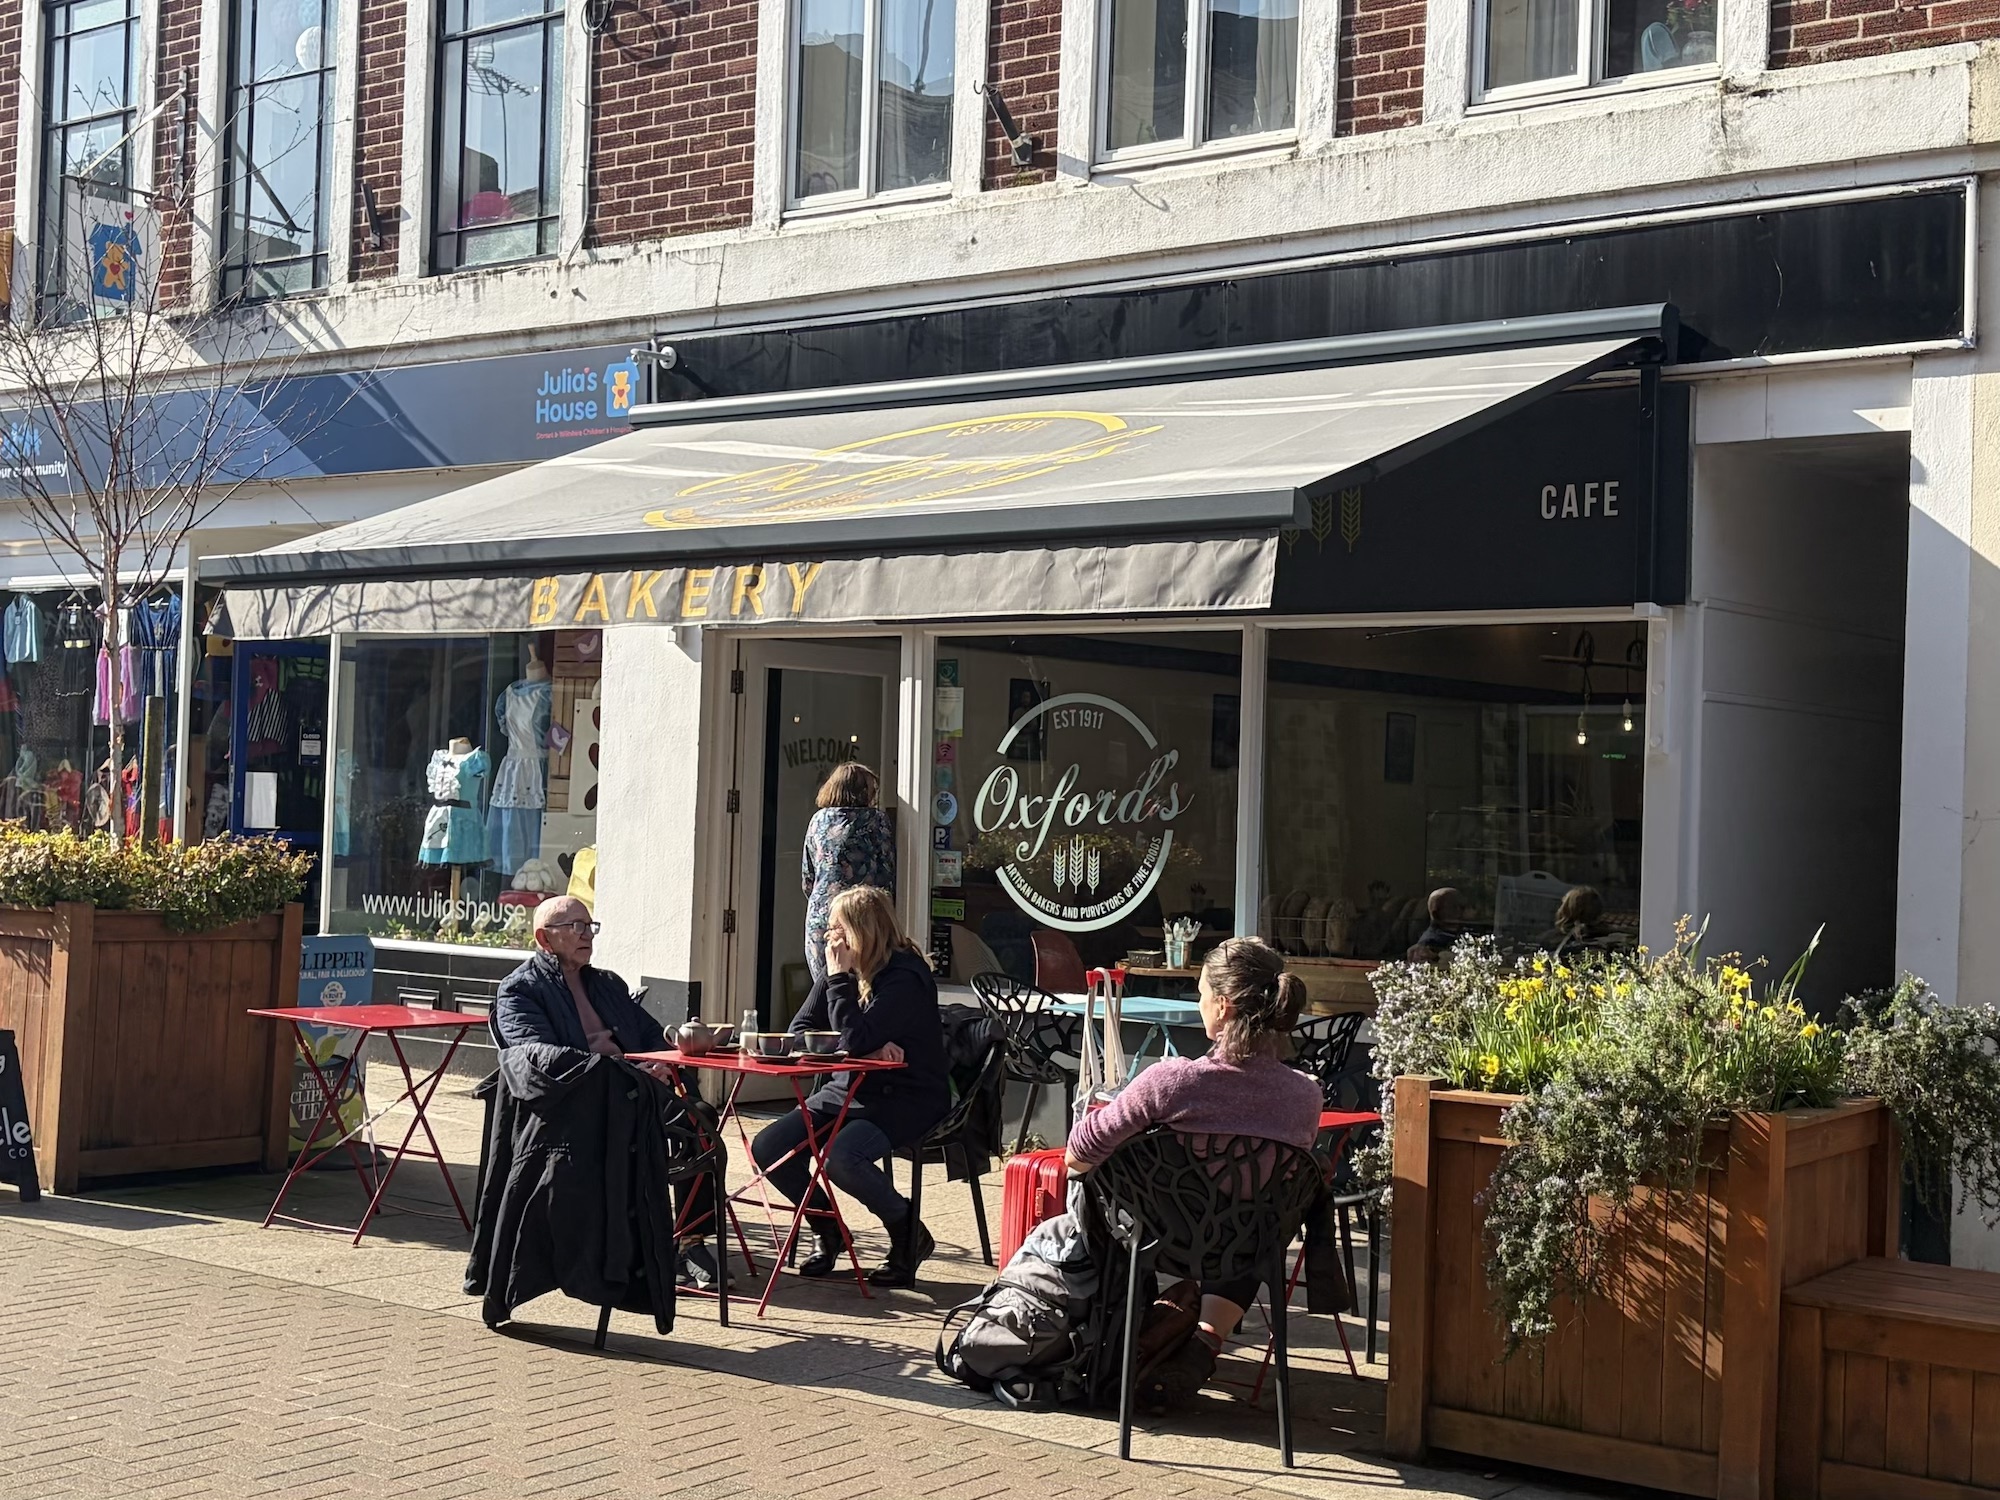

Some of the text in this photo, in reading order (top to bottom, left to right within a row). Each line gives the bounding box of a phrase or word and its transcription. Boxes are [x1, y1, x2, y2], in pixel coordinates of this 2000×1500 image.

[537, 367, 597, 396] Julia's
[536, 399, 598, 424] House
[0, 460, 67, 479] ur cmmunity
[1541, 481, 1620, 520] CAFE
[529, 563, 822, 625] BAKERY
[1053, 709, 1104, 730] EST 1911
[783, 737, 860, 769] WELCOME
[973, 749, 1195, 862] Oxford's
[1005, 836, 1162, 920] ARTISAN BAKERS AND PURVEYORS OF FINE FOODS
[301, 951, 365, 970] LIPPER
[298, 1078, 337, 1090] SERVNG
[303, 1070, 334, 1080] PRODLY
[0, 1107, 31, 1146] le
